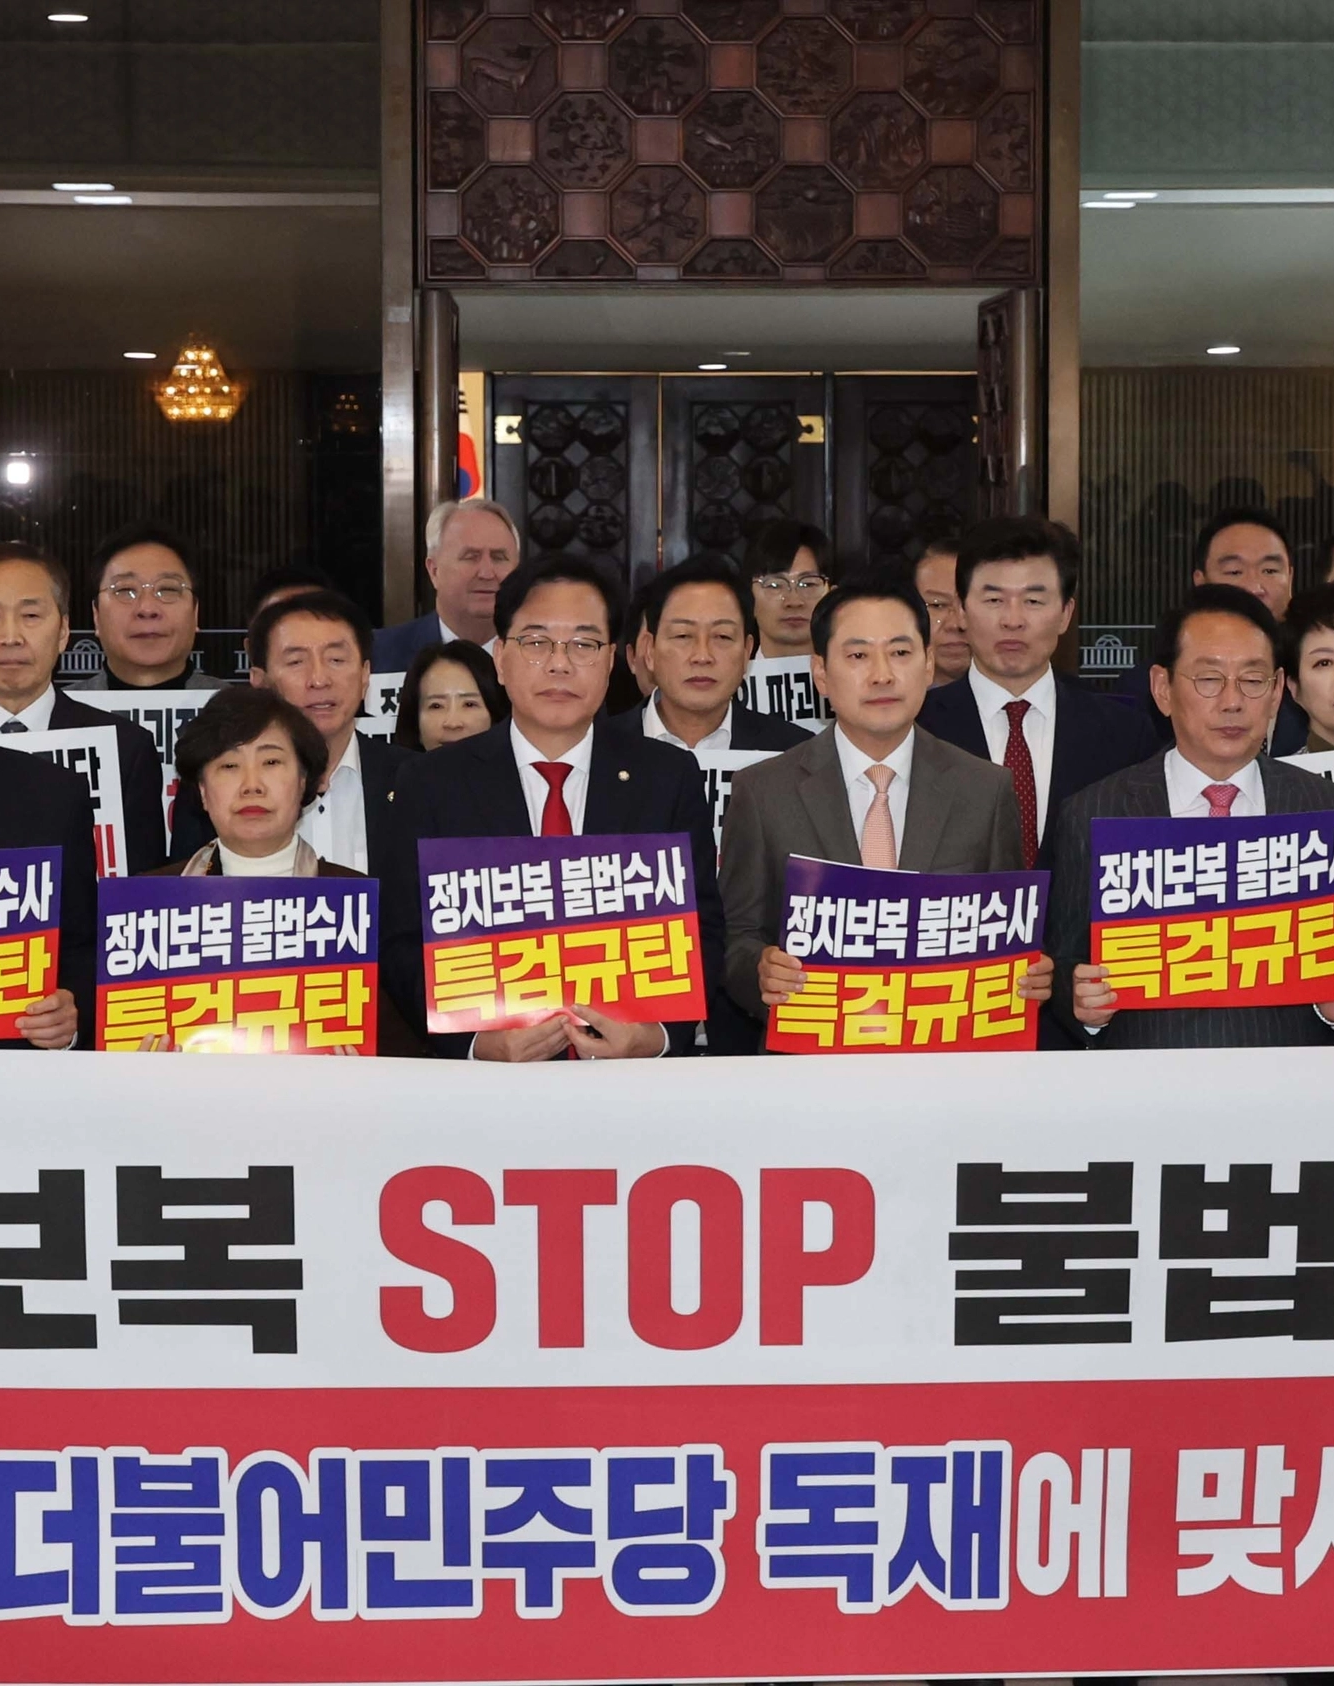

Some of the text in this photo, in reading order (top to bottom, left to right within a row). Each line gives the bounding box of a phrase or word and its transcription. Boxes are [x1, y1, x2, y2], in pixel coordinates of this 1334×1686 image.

[427, 846, 687, 935] 정치보복 불법수사
[784, 885, 1039, 960] 정치보복 불법수사
[1098, 840, 1228, 916] 정치보복
[104, 893, 370, 977] 정치보복 불법수사
[432, 919, 695, 1021] 특검규탄
[103, 968, 370, 1055] 특검규탄
[775, 958, 1030, 1047] 특검규탄
[378, 1164, 876, 1354] STOP
[757, 1440, 1131, 1617] 독재에
